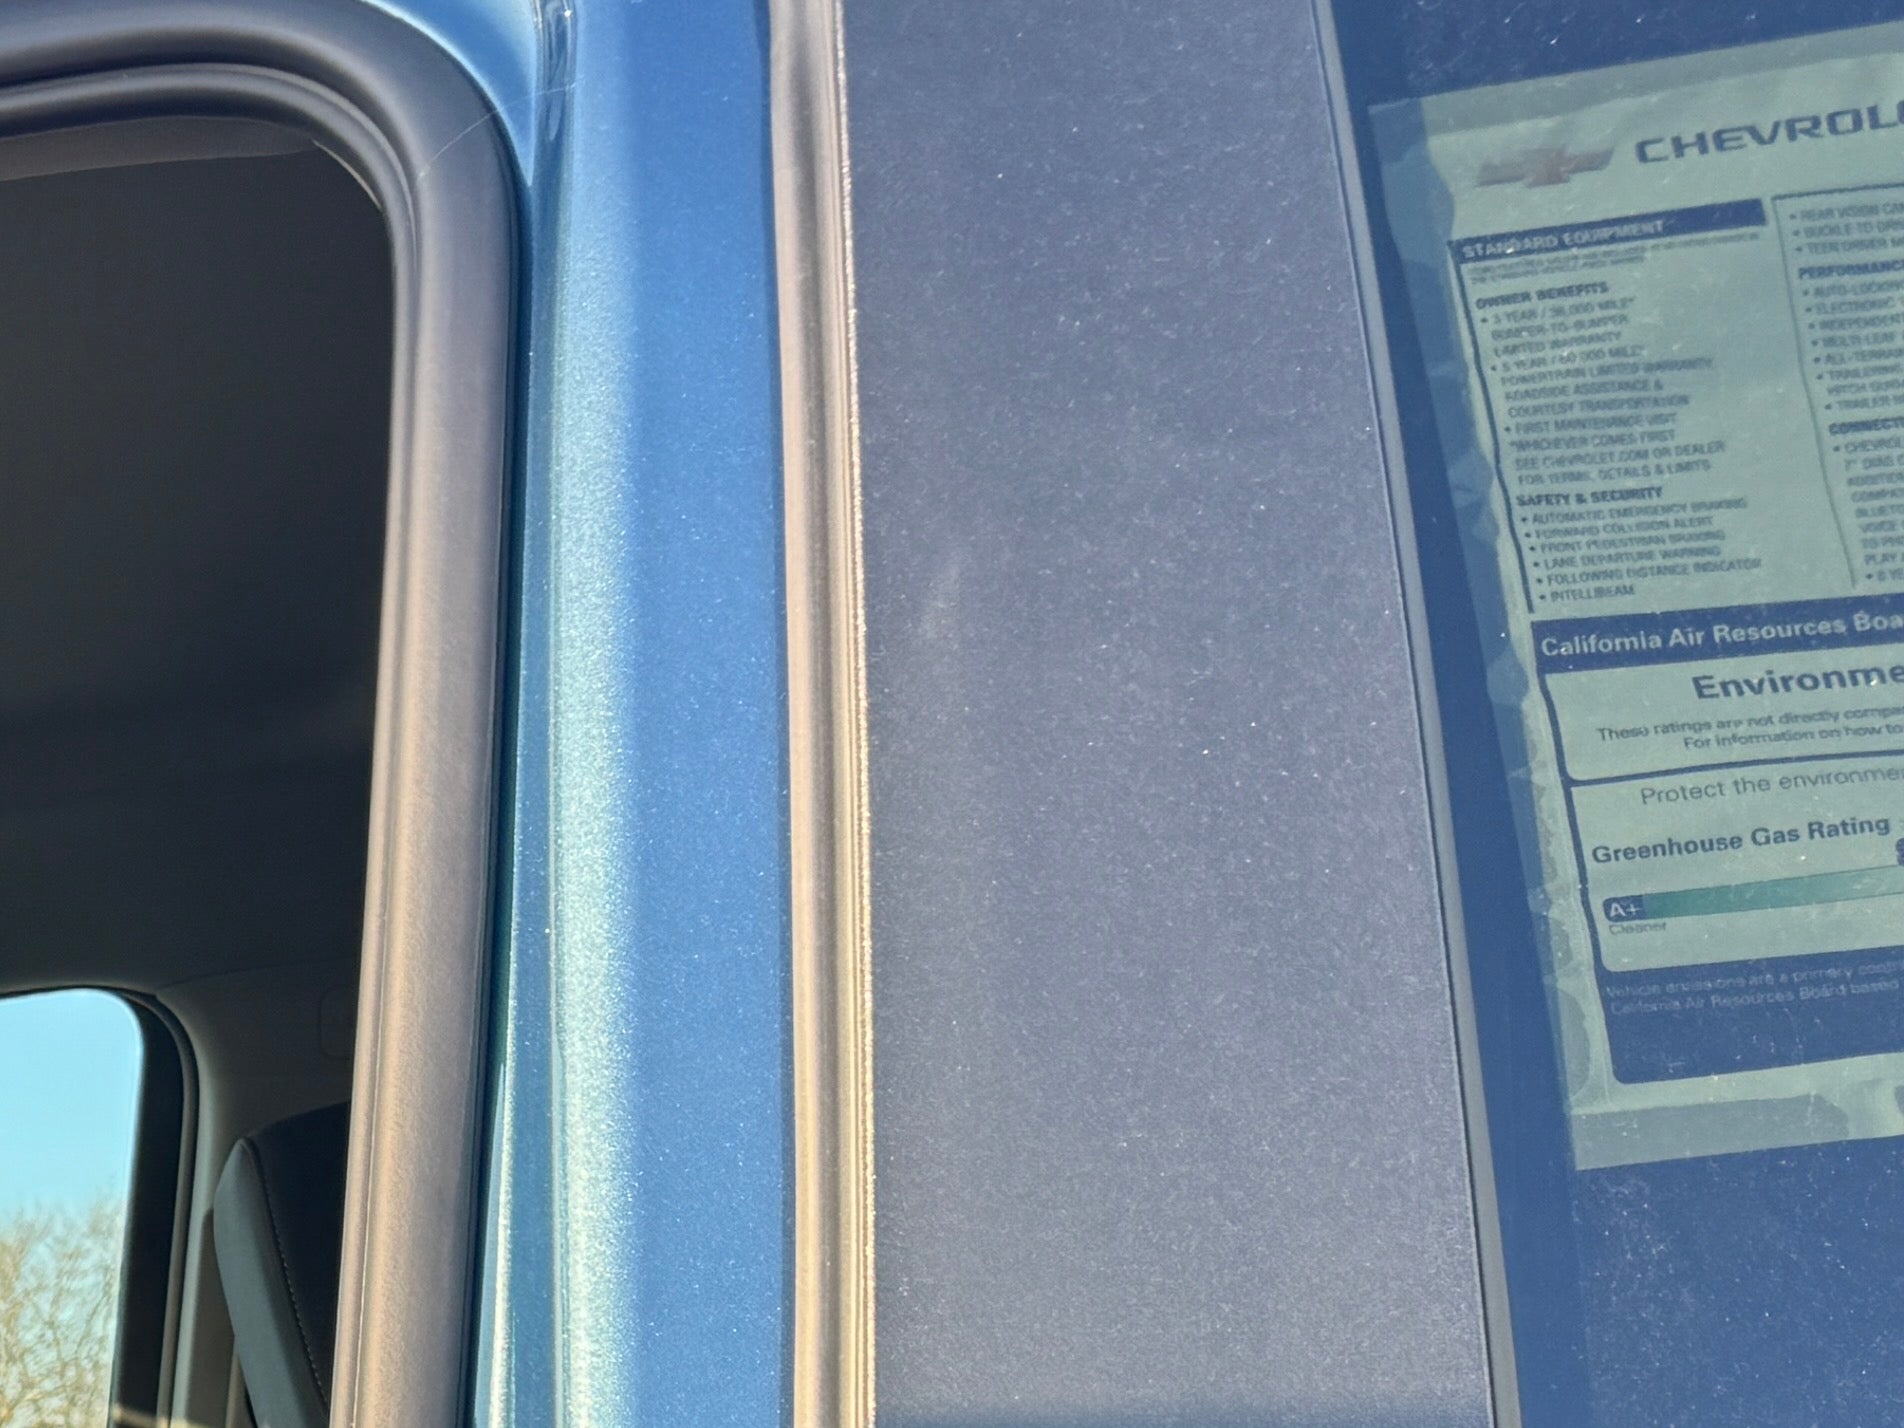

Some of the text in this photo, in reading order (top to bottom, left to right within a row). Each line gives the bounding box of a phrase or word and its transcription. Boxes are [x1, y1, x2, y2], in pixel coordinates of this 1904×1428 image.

[1635, 99, 1904, 164] CHEVROL
[1462, 219, 1665, 258] STANDARD EQUIPMENT
[1515, 493, 1571, 507] SAFETY
[1590, 486, 1664, 503] SECURITY
[1541, 629, 1663, 658] California
[1668, 627, 1706, 648] Air
[1712, 615, 1848, 643] Resources
[1598, 724, 1649, 743] These
[1653, 720, 1713, 738] ratings
[1746, 714, 1775, 728] not
[1777, 708, 1840, 727] directly
[1683, 736, 1712, 750] For
[1820, 726, 1841, 739] on
[1844, 722, 1883, 738] how
[1885, 722, 1904, 735] to
[1641, 781, 1726, 805] Protect
[1732, 778, 1772, 795] the
[1592, 816, 1892, 864] Greenhouse Gas Rating
[1608, 901, 1641, 918] A+
[1608, 921, 1667, 937] Cleaner
[1711, 991, 1794, 1008] Resources
[1798, 985, 1848, 1001] Board
[1850, 979, 1899, 996] based
